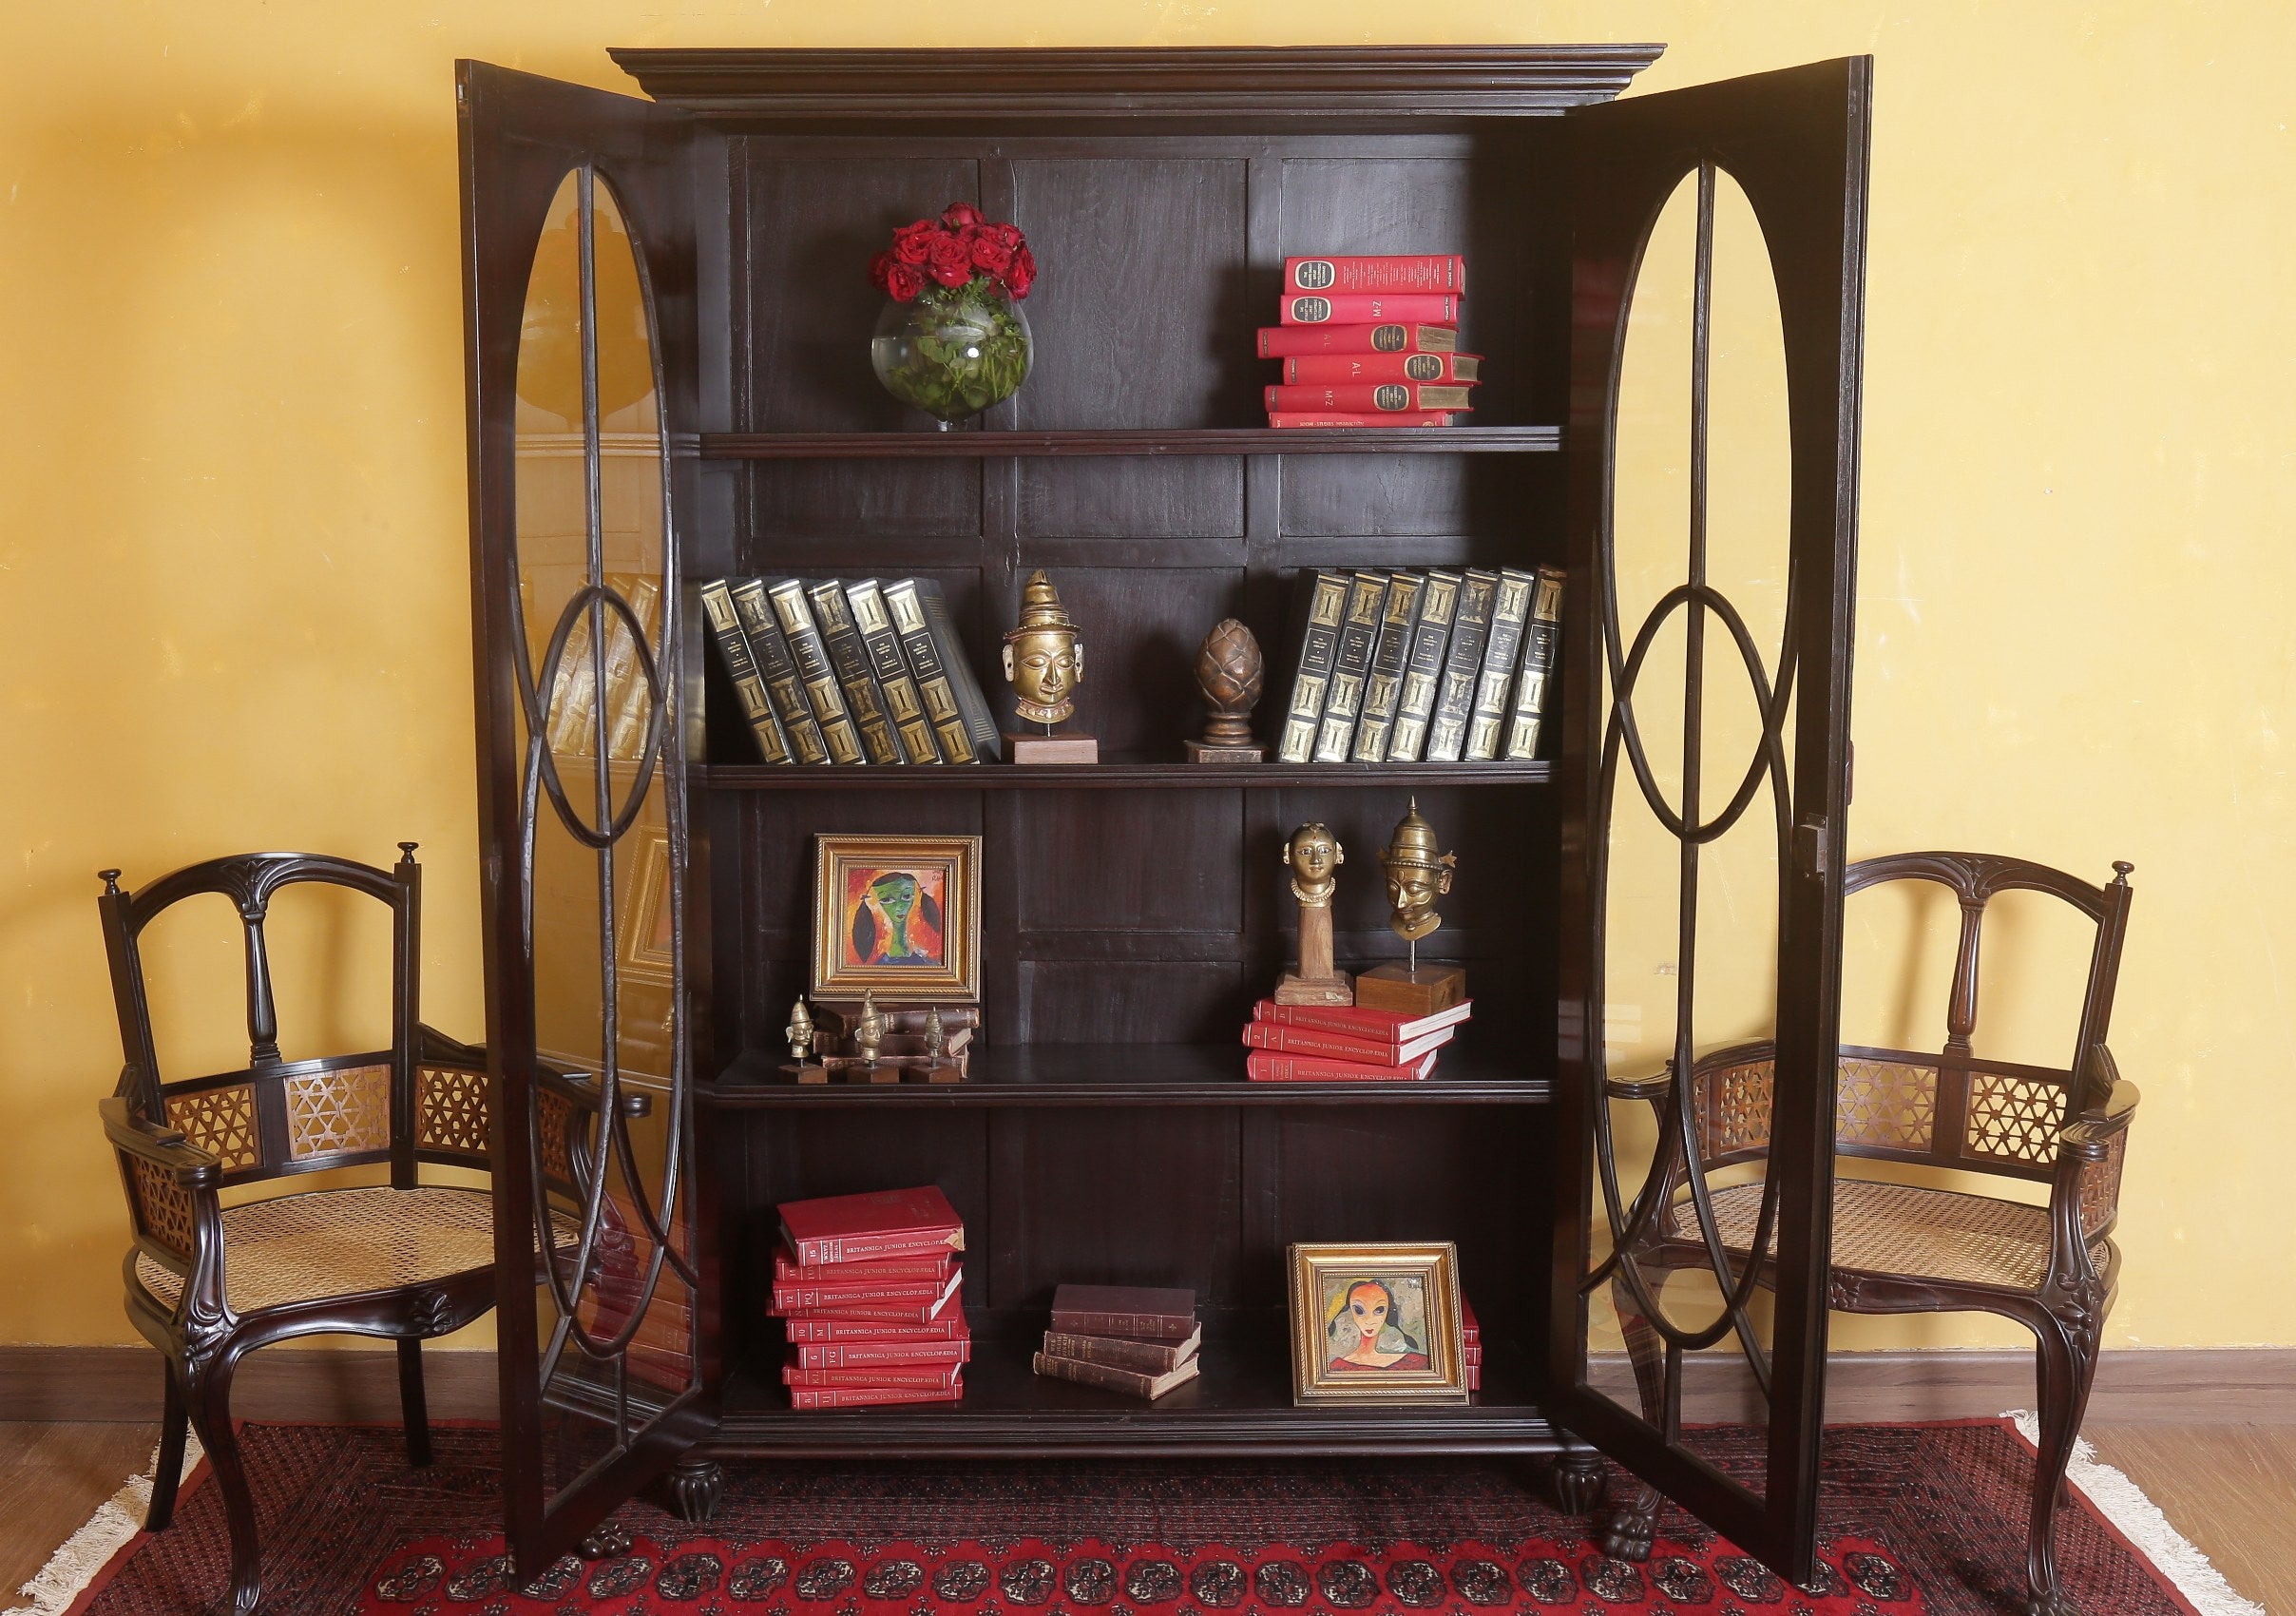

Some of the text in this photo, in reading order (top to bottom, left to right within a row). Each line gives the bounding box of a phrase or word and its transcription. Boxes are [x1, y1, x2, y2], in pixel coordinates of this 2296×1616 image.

[1296, 1016, 1326, 1026] BRITANNICA
[1288, 1039, 1321, 1048] BRITANNICA
[1322, 1043, 1344, 1051] JUNIOR
[846, 1245, 883, 1253] BRITANNICA
[884, 1242, 906, 1251] JUNIOR
[805, 1292, 814, 1305] PQ
[829, 1351, 836, 1363] FG
